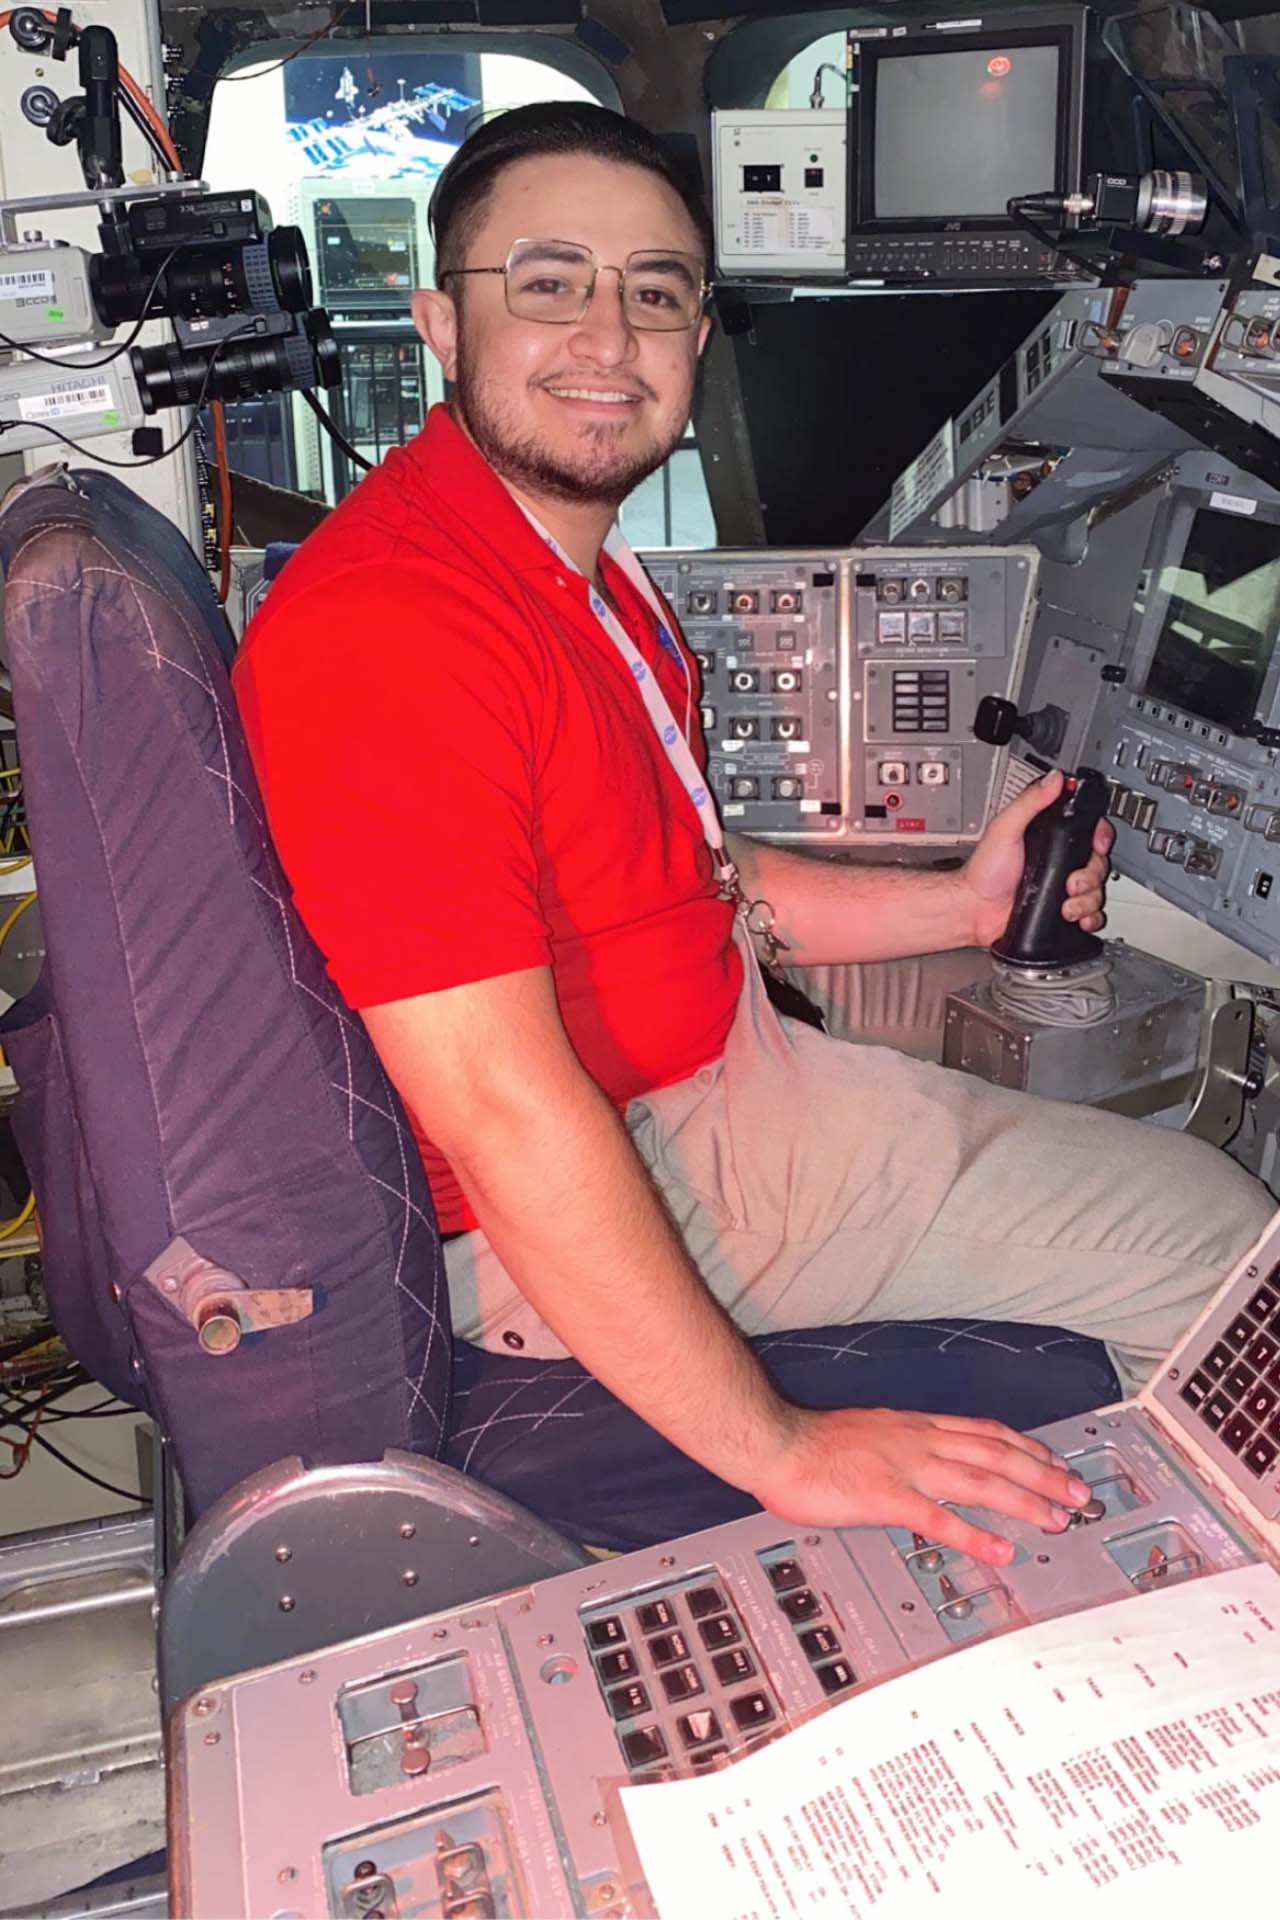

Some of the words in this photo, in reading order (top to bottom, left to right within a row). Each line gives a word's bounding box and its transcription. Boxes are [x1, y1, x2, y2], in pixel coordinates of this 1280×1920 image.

[944, 222, 961, 231] JVC
[51, 375, 105, 394] HITACHI
[1257, 1347, 1268, 1361] 7
